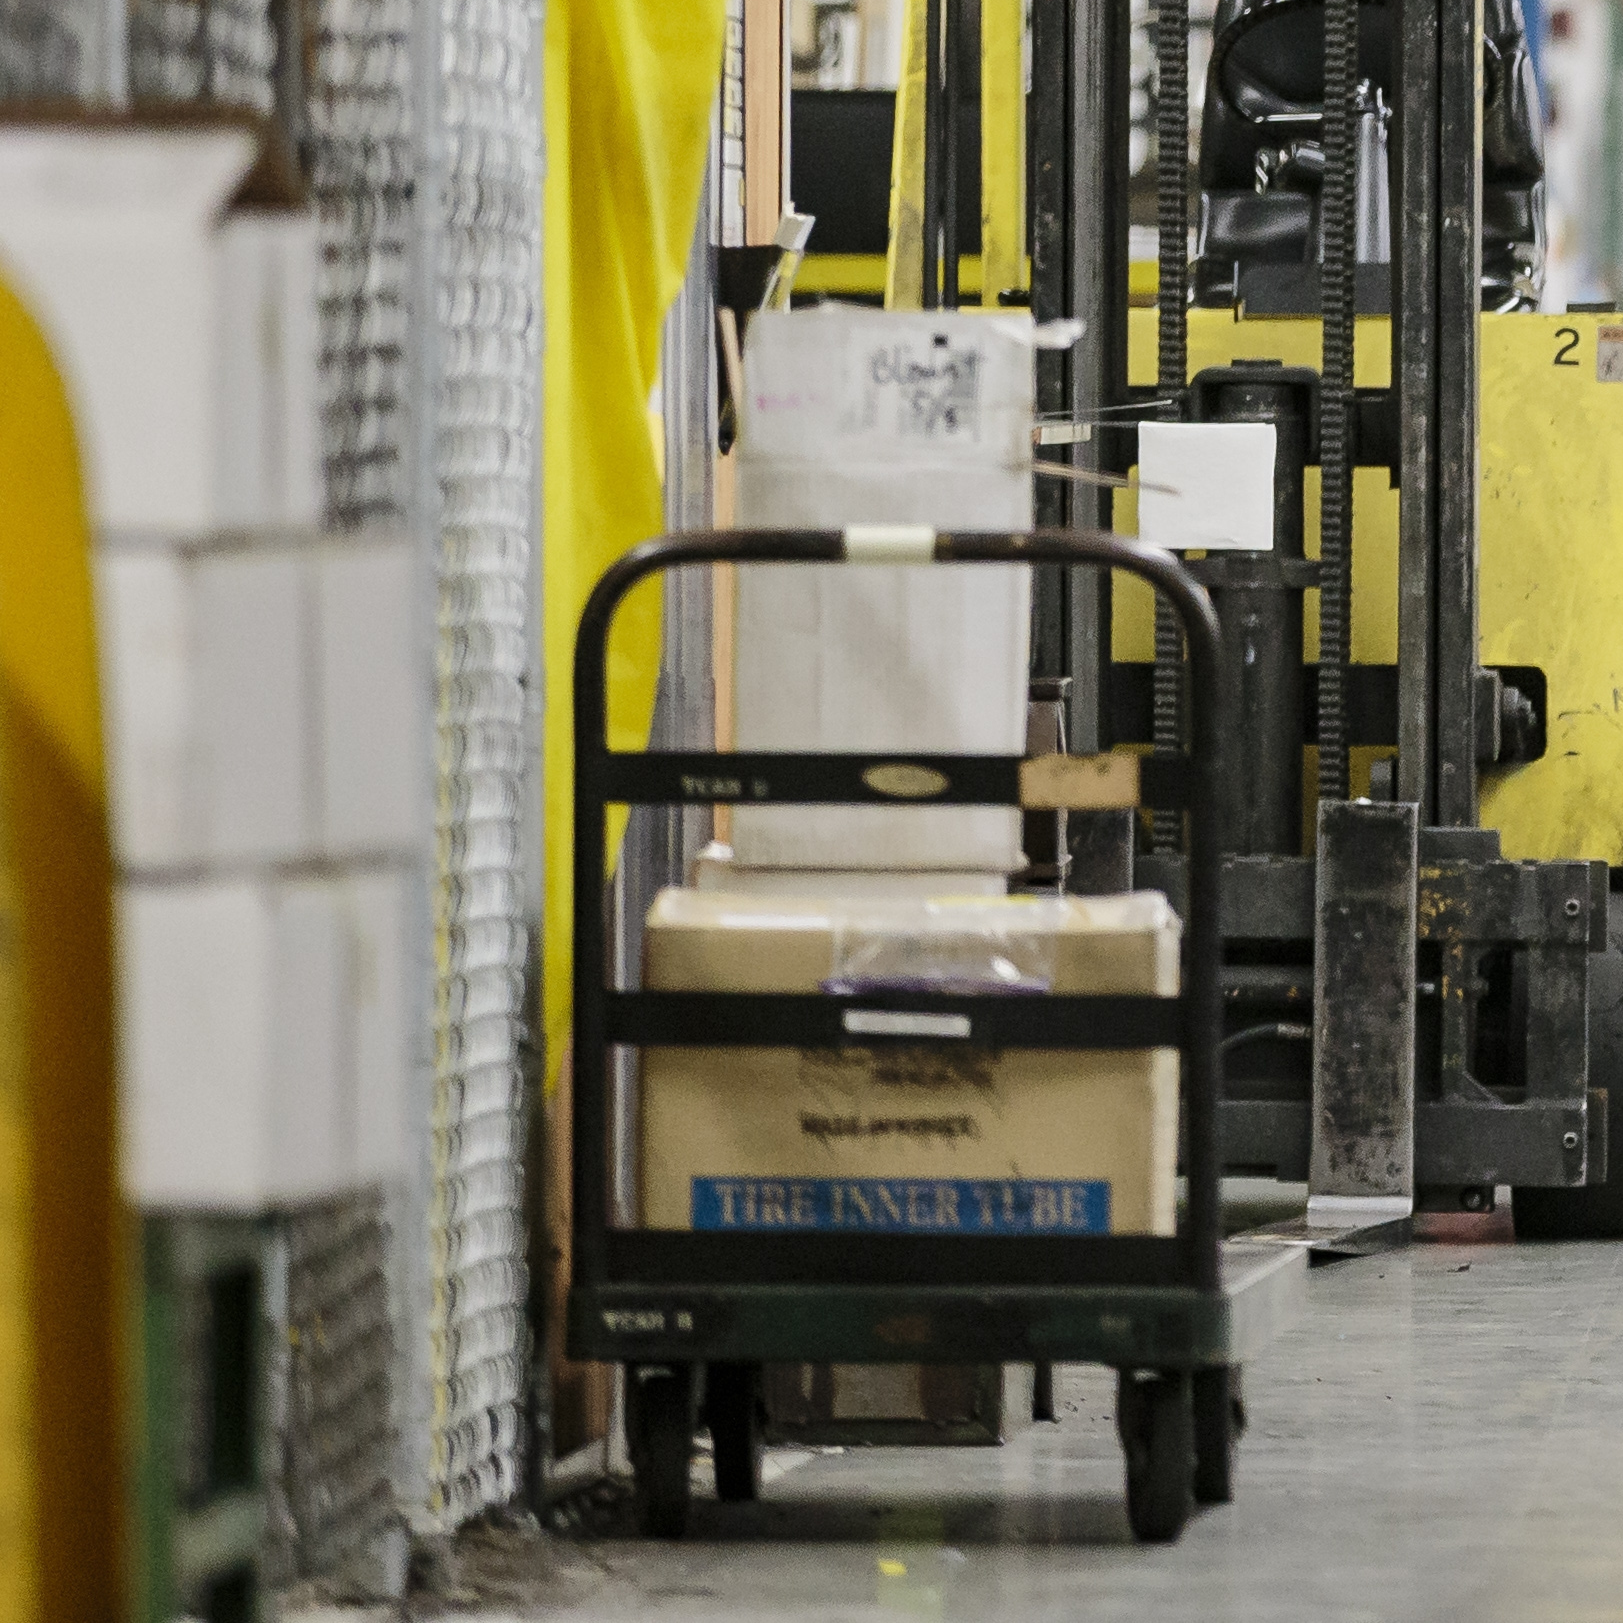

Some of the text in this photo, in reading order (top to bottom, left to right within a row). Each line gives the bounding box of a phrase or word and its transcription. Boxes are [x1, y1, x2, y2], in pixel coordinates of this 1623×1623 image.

[1553, 325, 1582, 367] 2
[714, 1181, 1090, 1227] TIRE INNER TUBE
